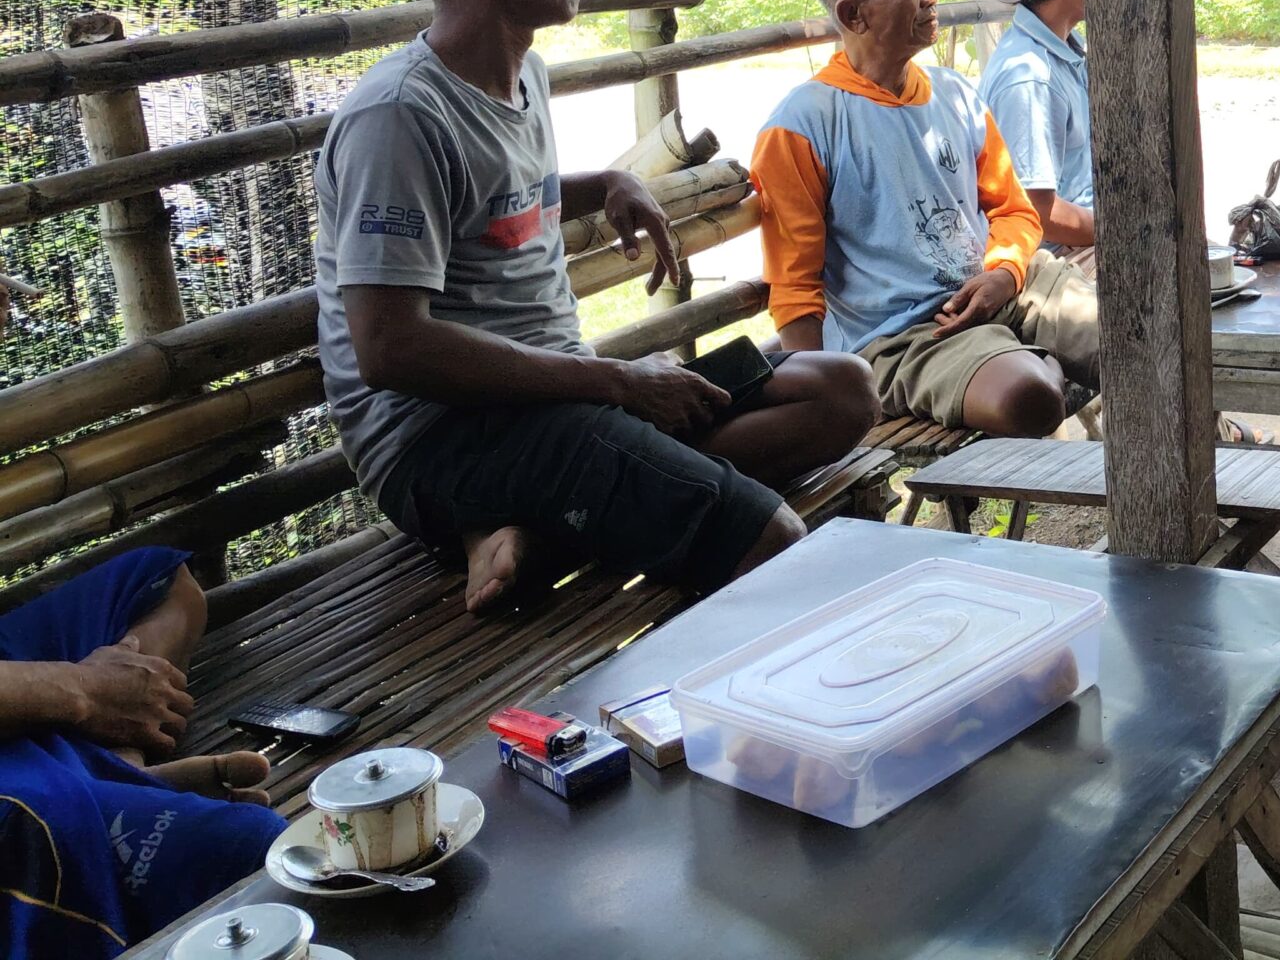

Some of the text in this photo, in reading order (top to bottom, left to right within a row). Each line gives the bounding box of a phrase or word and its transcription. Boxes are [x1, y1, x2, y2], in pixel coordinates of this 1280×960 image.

[486, 182, 543, 216] TRUST
[361, 203, 425, 225] R.98
[384, 223, 421, 237] TRUST
